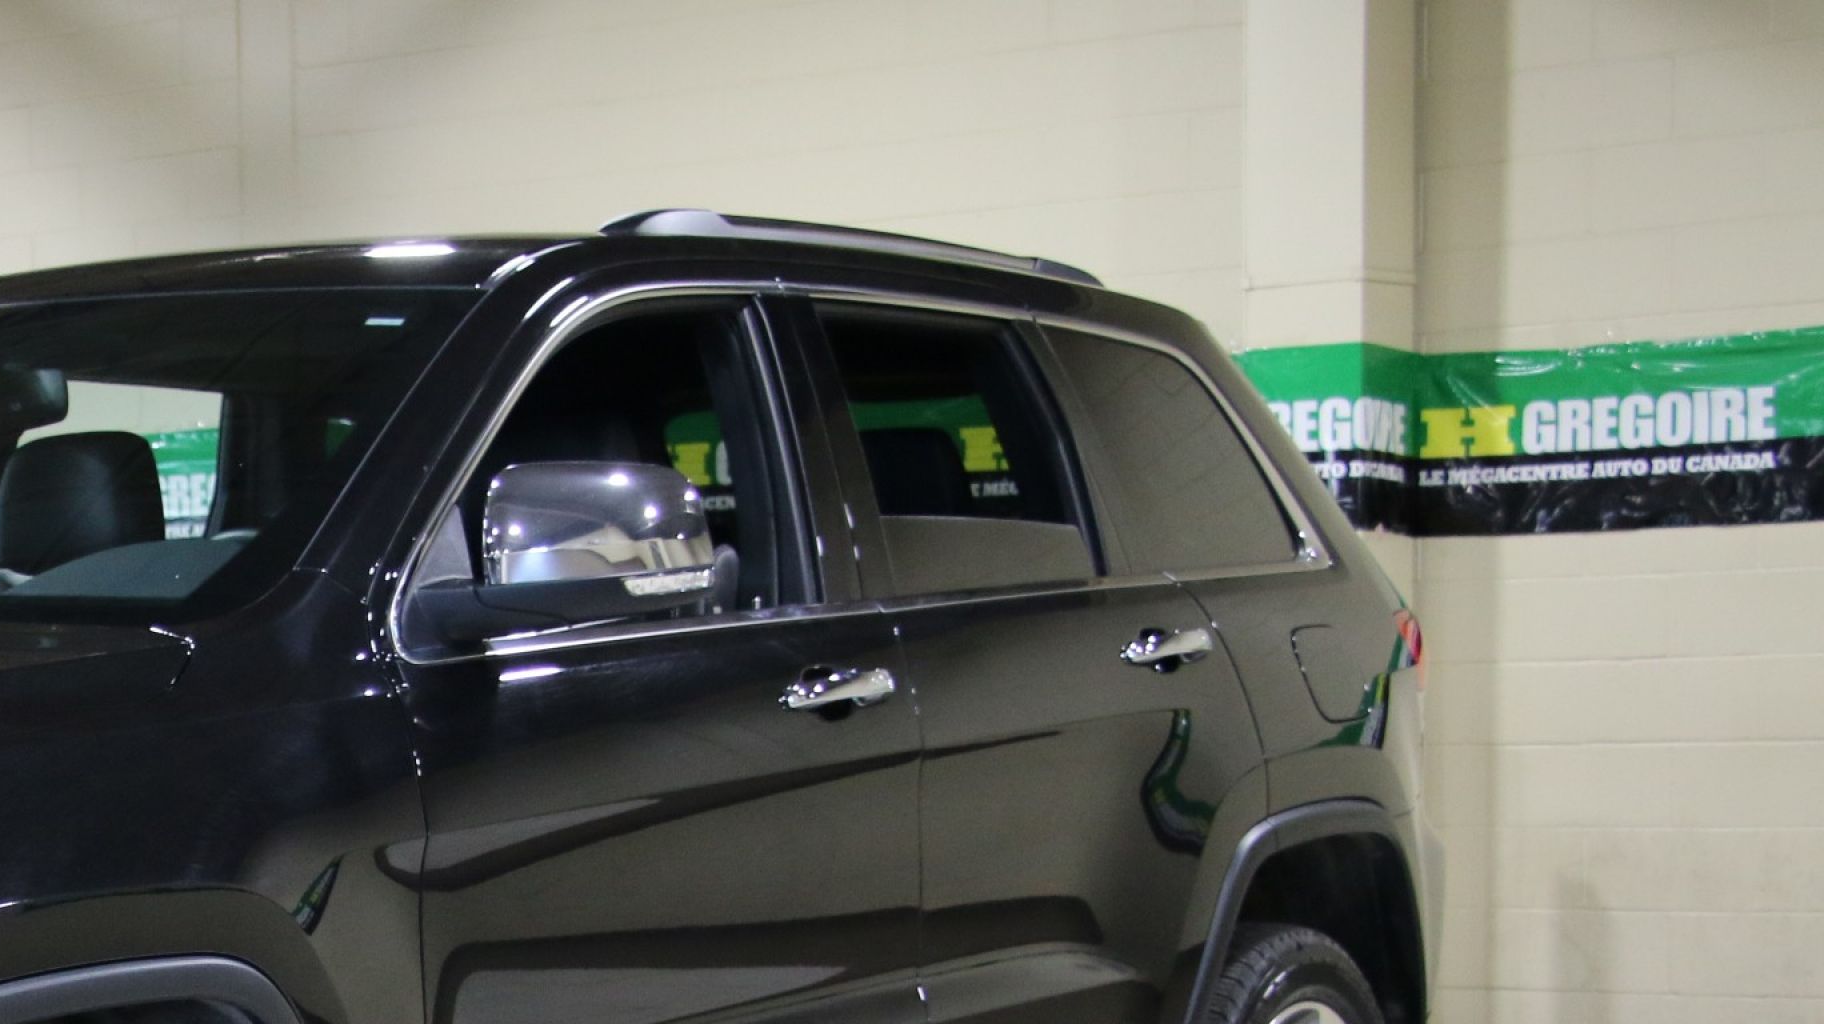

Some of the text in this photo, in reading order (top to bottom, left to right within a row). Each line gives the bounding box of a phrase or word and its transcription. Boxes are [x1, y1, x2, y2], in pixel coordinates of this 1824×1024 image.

[1419, 386, 1776, 459] H GREGOIRE
[1418, 469, 1445, 487] LE
[1591, 458, 1649, 479] AUTO
[1651, 456, 1684, 475] DU
[1685, 451, 1776, 473] CANADA
